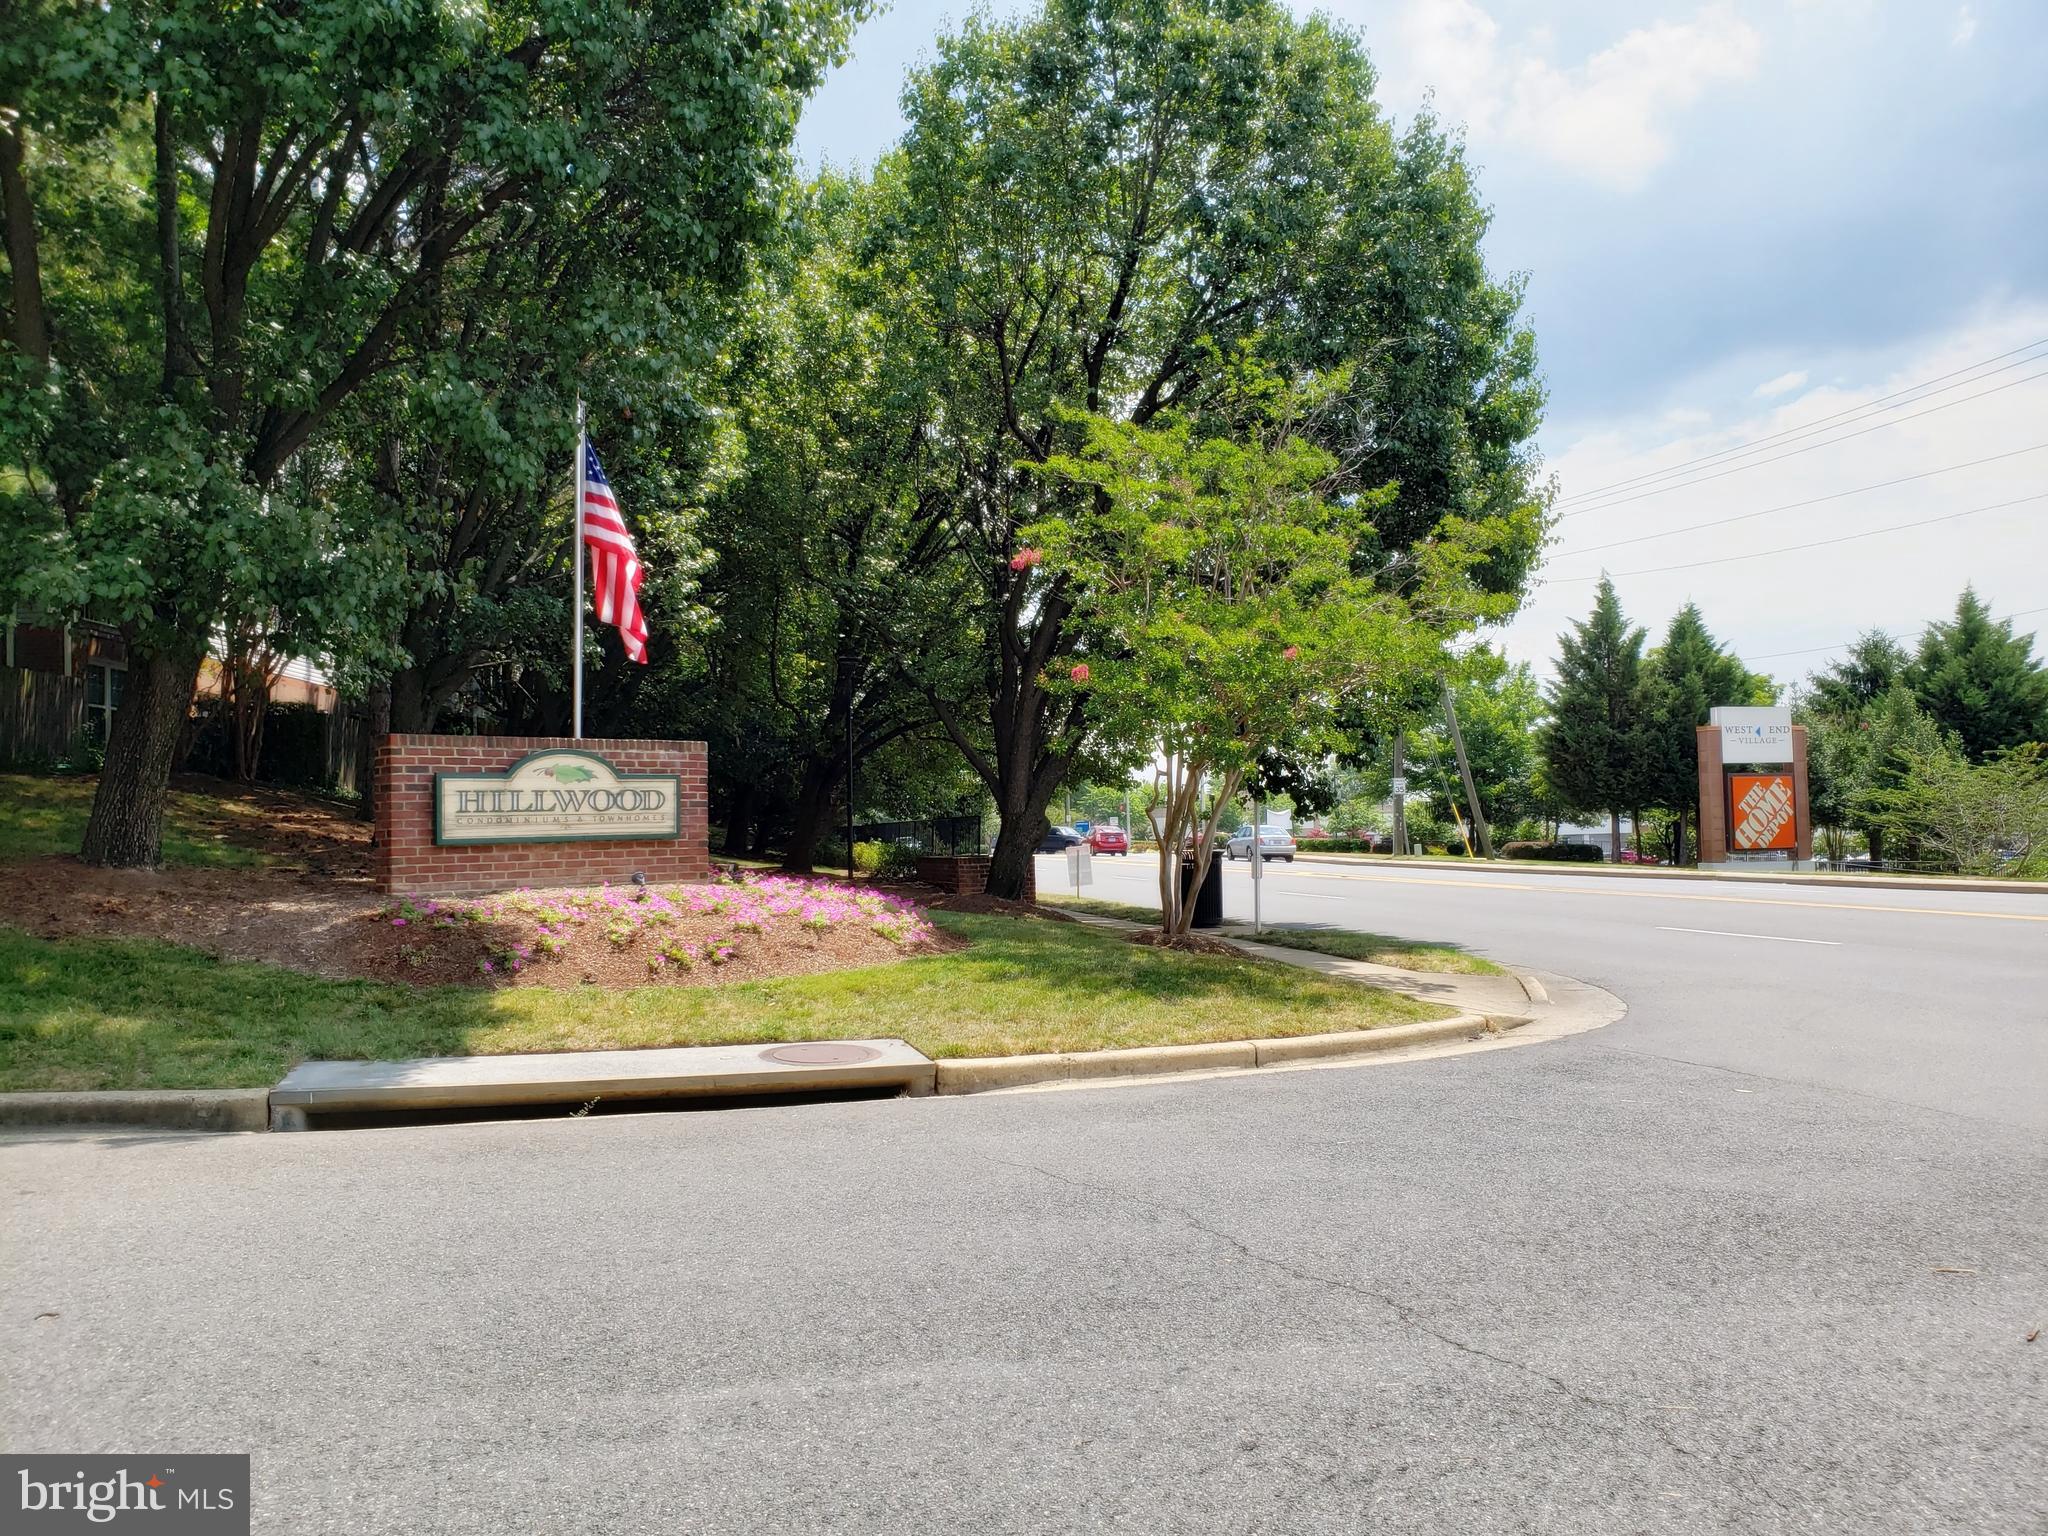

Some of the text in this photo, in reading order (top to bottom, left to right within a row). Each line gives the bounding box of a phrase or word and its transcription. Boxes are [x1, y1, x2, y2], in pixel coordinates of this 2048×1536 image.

[1724, 725, 1790, 734] WEST END
[456, 789, 665, 813] HILLWOOD
[1738, 781, 1766, 814] THE
[457, 816, 569, 825] CONDOMINIUMS
[593, 814, 665, 823] TOWNHOMES
[1735, 777, 1792, 849] HOME
[1756, 800, 1794, 849] DEPOT
